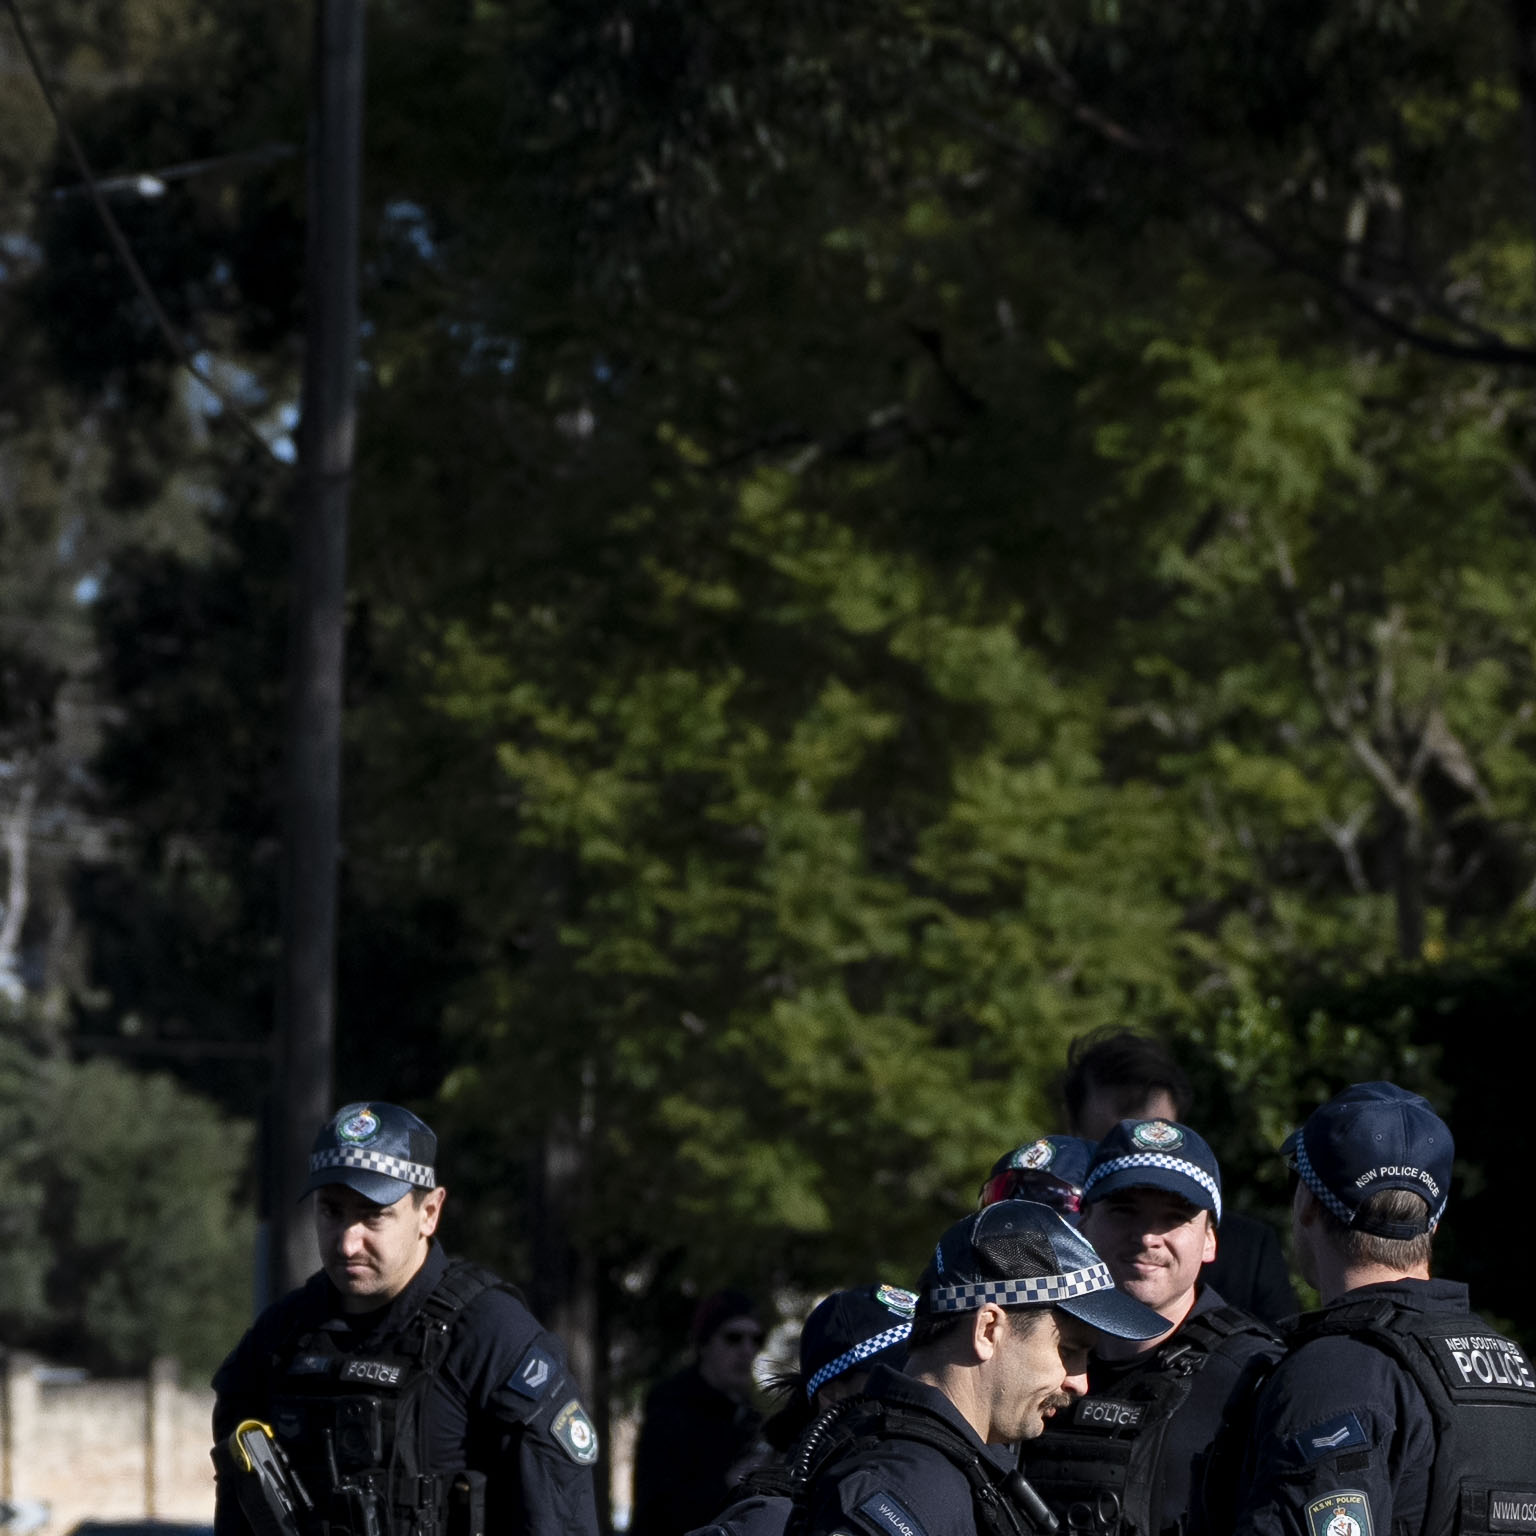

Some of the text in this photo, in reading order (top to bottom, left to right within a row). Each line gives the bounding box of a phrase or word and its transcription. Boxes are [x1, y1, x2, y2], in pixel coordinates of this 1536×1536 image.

[1354, 1165, 1440, 1198] NSW POLICE FORCE
[1444, 1336, 1470, 1351] NEW
[1470, 1336, 1500, 1352] SOUTH
[347, 1364, 399, 1384] POLICE
[1451, 1349, 1536, 1388] POLICE
[1081, 1406, 1141, 1425] POLICE
[1312, 1496, 1362, 1513] N.S.W. POLICE
[1492, 1501, 1520, 1520] NWM
